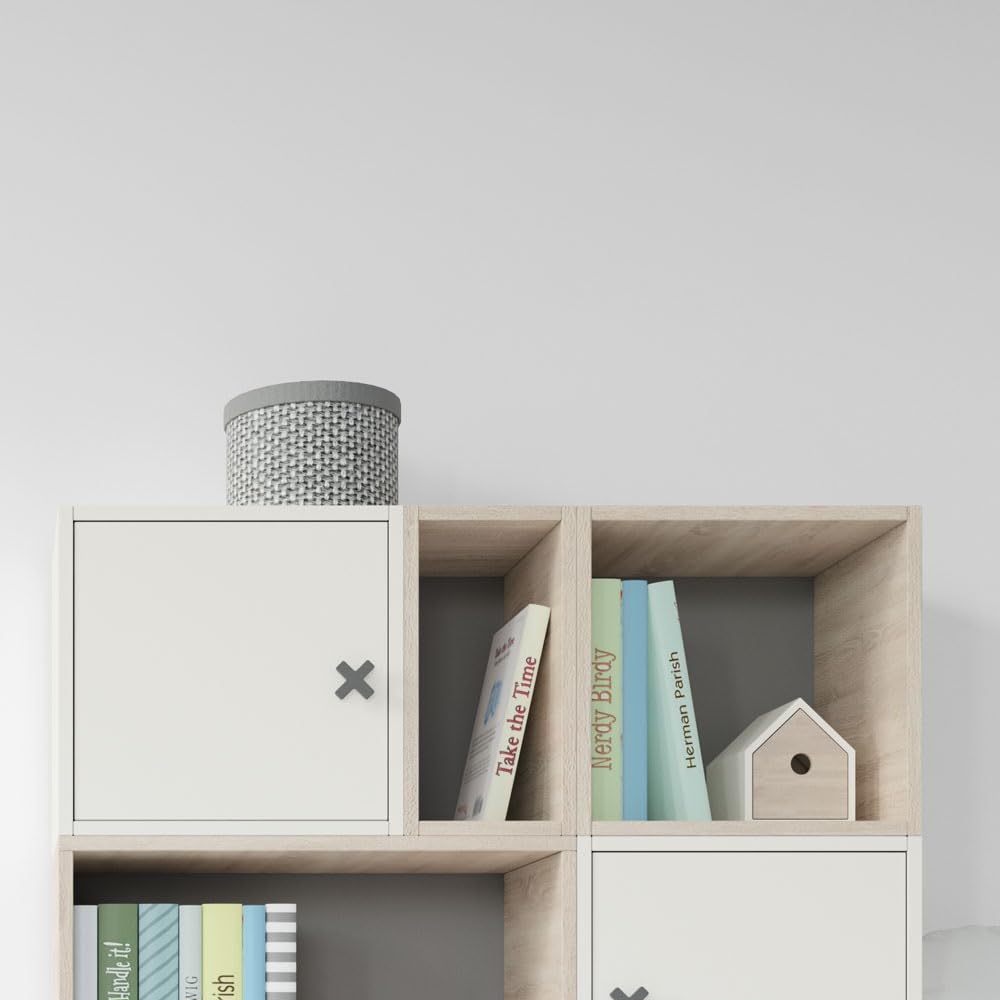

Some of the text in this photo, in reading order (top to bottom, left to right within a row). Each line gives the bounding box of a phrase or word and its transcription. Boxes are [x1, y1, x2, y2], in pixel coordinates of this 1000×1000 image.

[496, 656, 537, 776] Take the Time
[591, 709, 617, 771] Nerdy
[669, 651, 697, 769] Herman Parish
[103, 941, 132, 959] it!
[105, 960, 132, 1000] Handle
